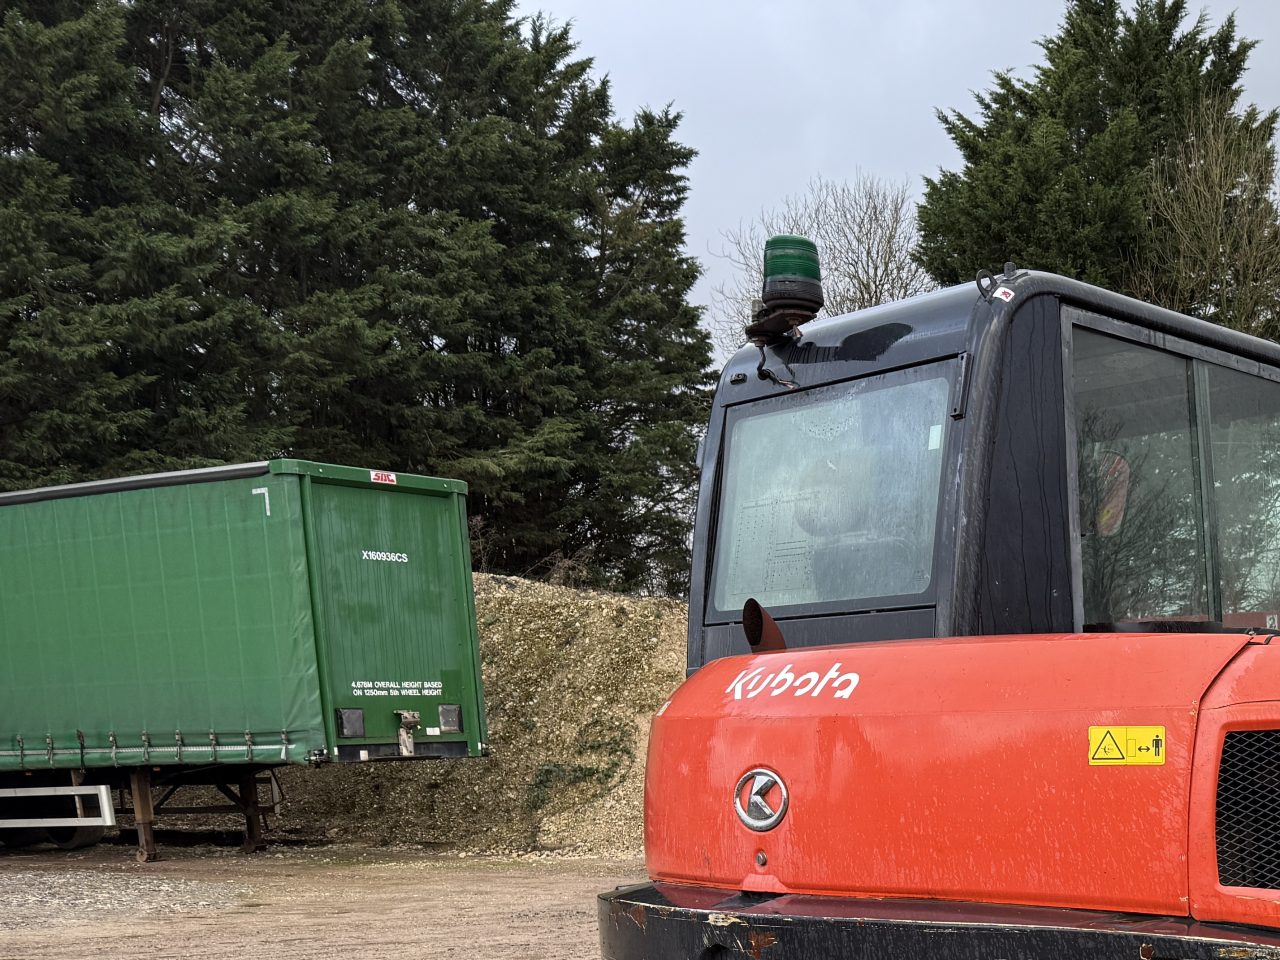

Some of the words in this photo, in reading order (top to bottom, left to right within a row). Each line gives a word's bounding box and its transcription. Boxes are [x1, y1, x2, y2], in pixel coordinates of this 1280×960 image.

[362, 550, 408, 562] X160936CS
[374, 681, 400, 689] OVERALL
[401, 681, 422, 689] HEIGHT
[423, 681, 442, 689] BASED
[725, 662, 860, 700] Kubota
